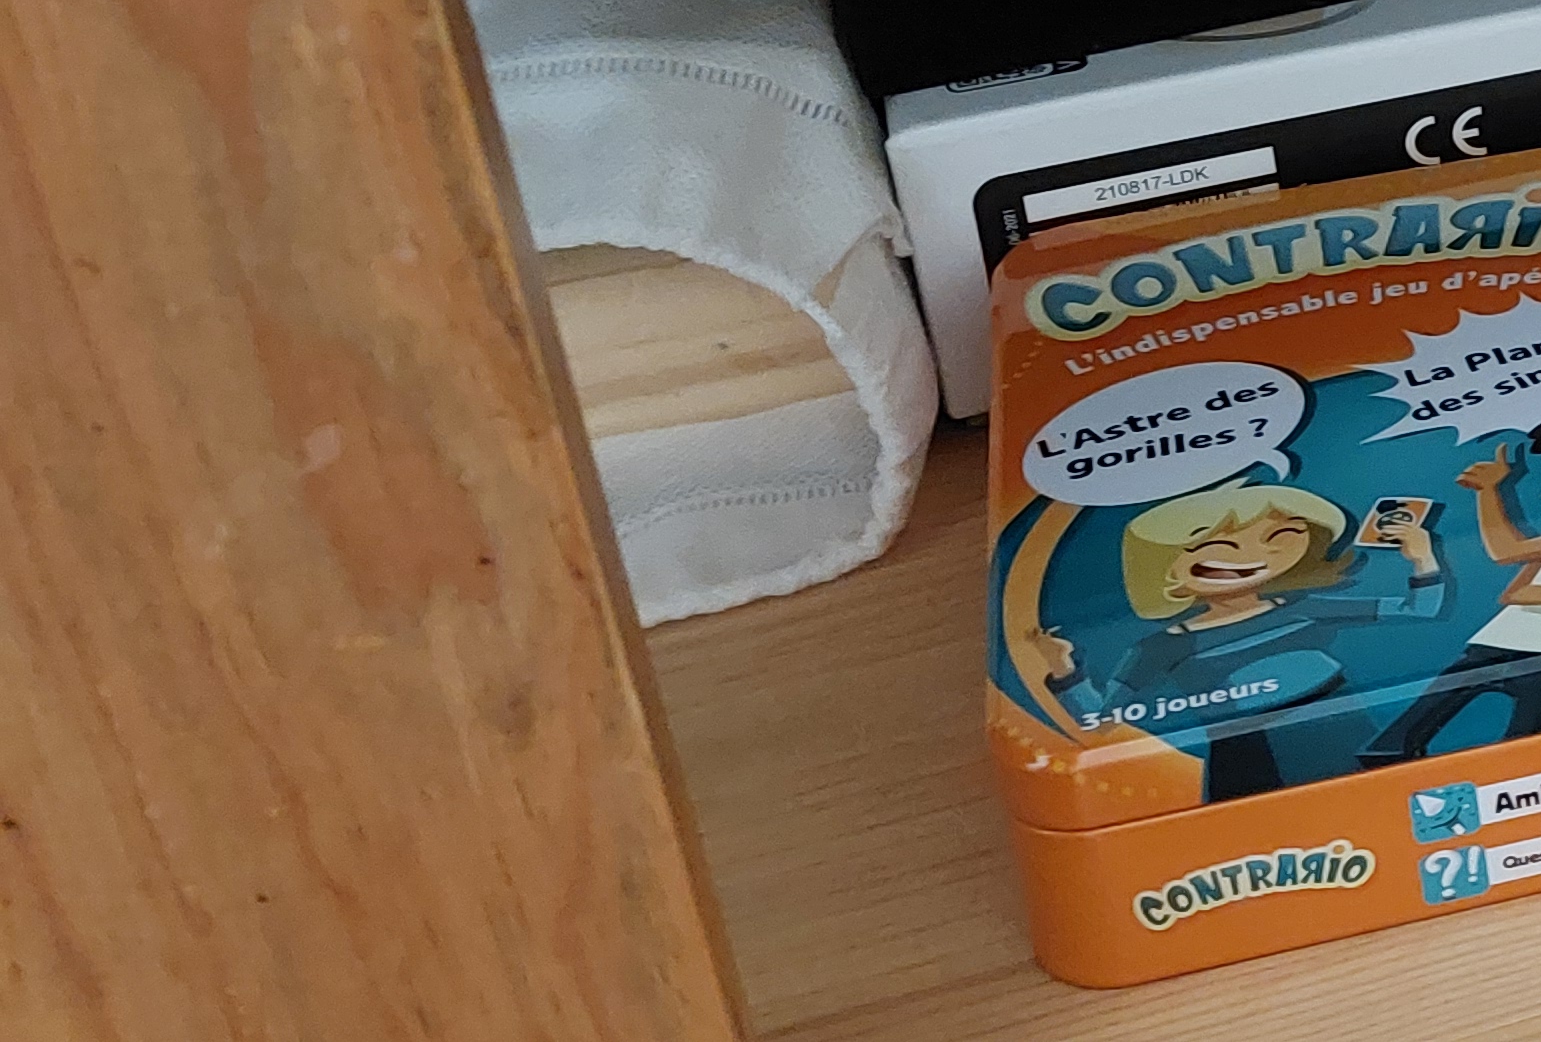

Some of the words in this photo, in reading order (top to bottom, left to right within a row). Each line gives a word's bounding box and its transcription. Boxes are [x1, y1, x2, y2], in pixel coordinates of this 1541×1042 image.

[1093, 165, 1211, 203] 210817-LDK
[1064, 282, 1360, 378] L'indispensable
[1368, 276, 1438, 308] jeu
[1403, 361, 1456, 389] La
[1410, 385, 1486, 424] des
[1035, 399, 1196, 459] L'Astre
[1203, 376, 1281, 415] des
[1066, 430, 1239, 482] gorilles
[1249, 417, 1269, 440] ?
[1080, 703, 1148, 734] 3-10
[1151, 674, 1281, 726] joueurs
